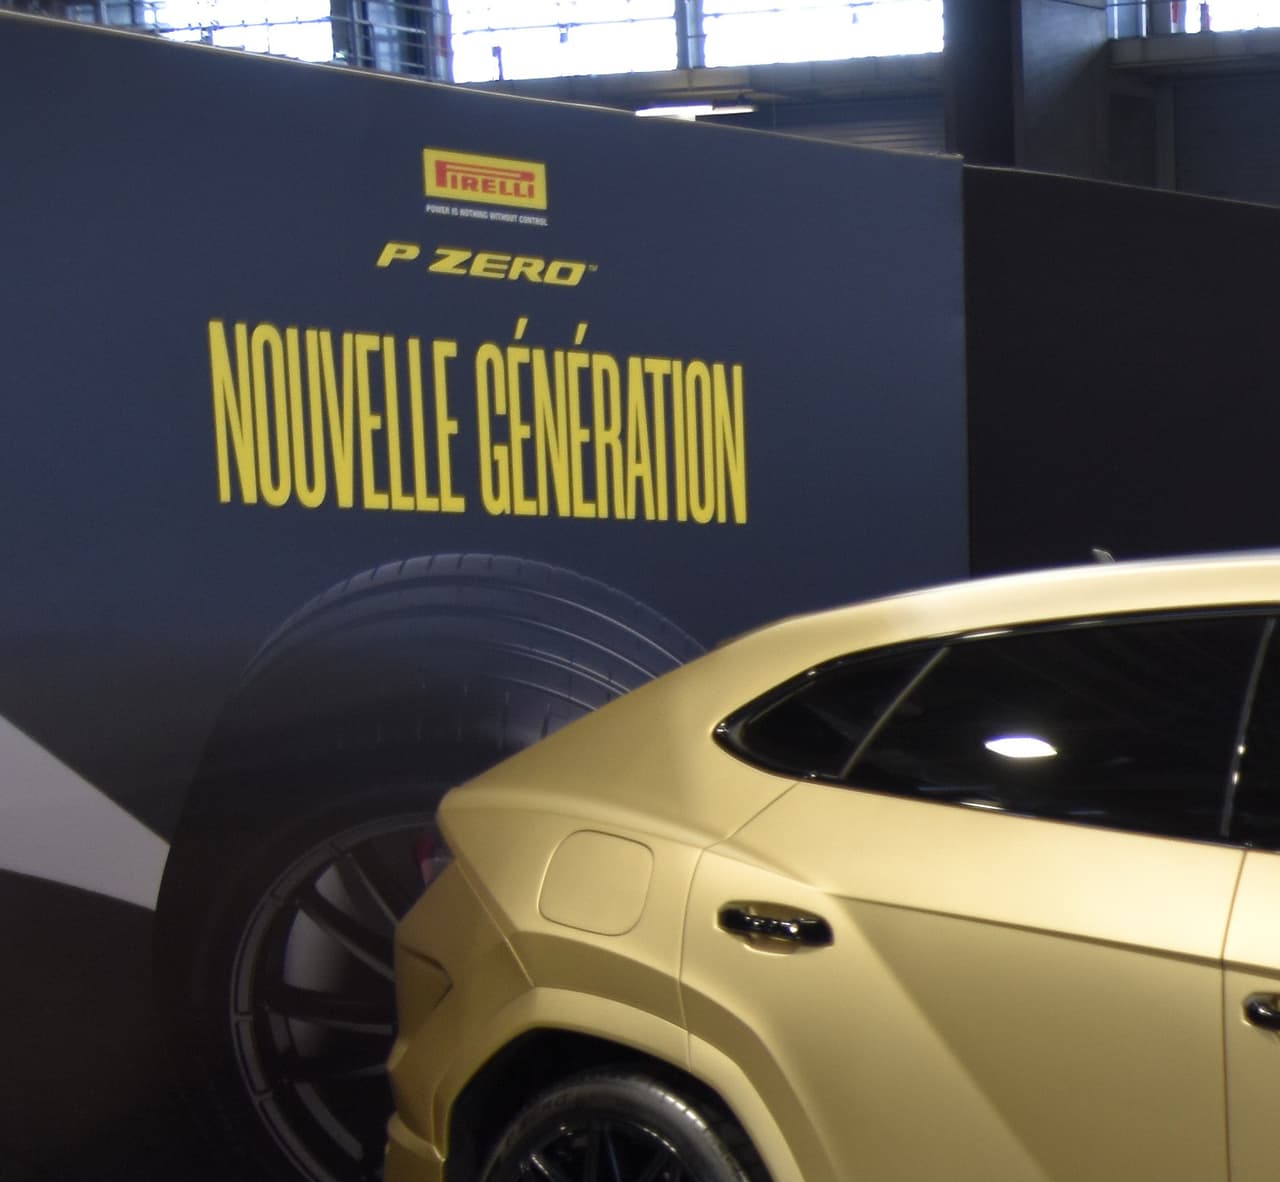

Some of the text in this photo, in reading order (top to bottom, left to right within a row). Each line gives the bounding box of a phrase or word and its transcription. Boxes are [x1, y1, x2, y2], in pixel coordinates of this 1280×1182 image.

[434, 159, 536, 199] PIRELLI
[425, 203, 450, 215] POWER
[460, 208, 489, 219] NOTHING
[490, 212, 518, 222] WITHOUT
[519, 216, 548, 226] CONTROL
[376, 242, 586, 286] P ZERO
[208, 316, 748, 525] NOUVELLE GÉNÉRATION
